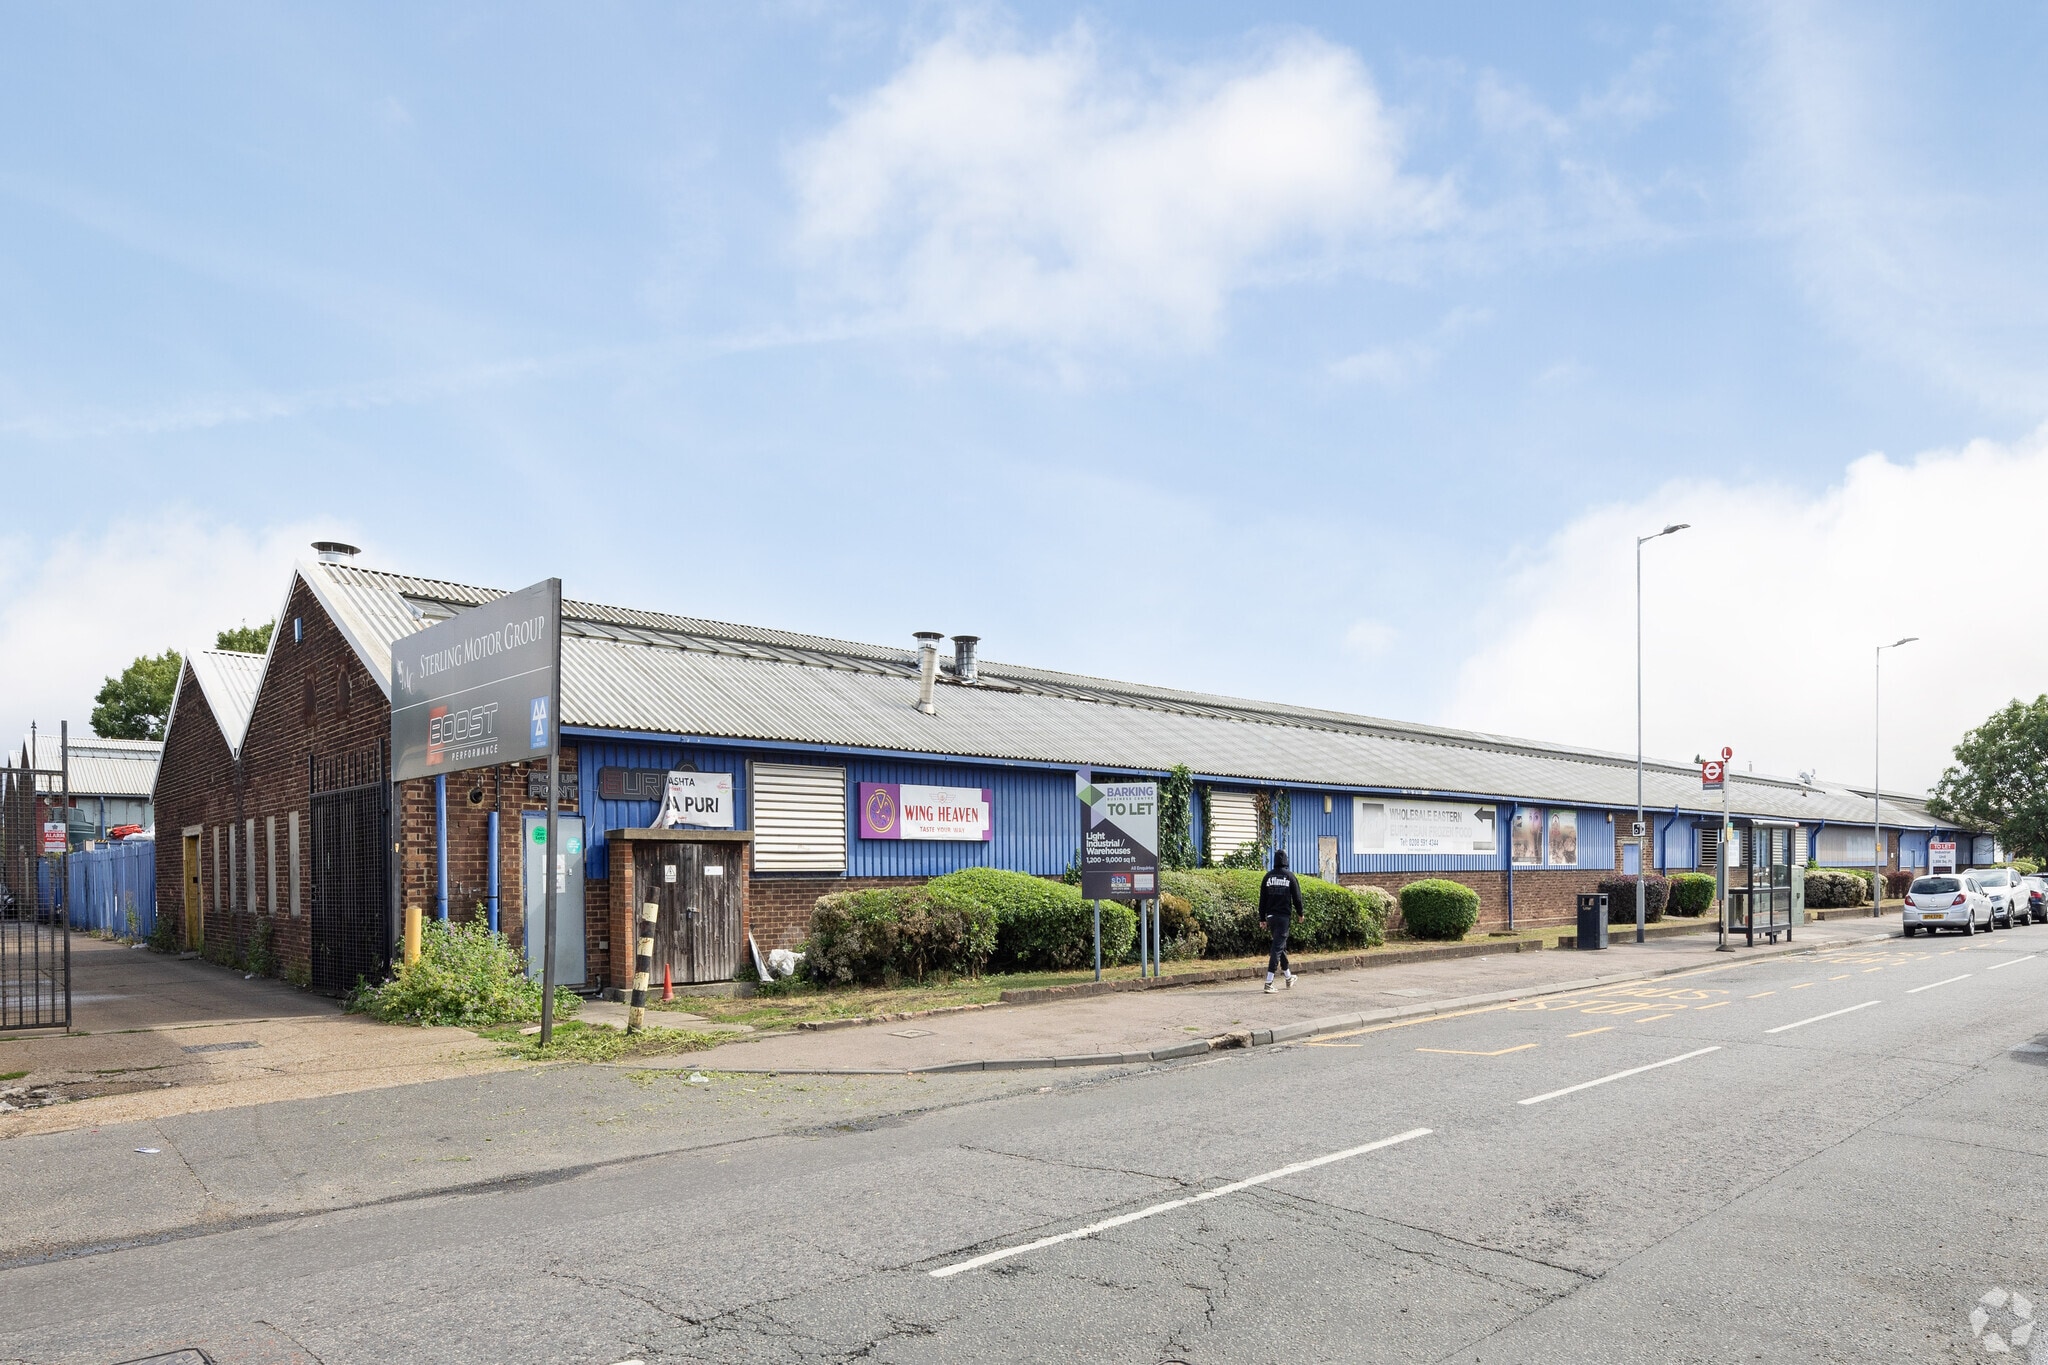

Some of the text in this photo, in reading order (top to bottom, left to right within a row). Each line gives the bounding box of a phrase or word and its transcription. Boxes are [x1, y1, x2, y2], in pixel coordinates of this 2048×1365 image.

[419, 615, 545, 679] STERLING MOTOR GROUP
[429, 702, 499, 747] BOOST
[451, 744, 498, 761] PERFORMANCE
[1723, 748, 1730, 758] L
[561, 773, 578, 783] UP
[529, 784, 578, 798] PONT
[1107, 786, 1154, 797] BARKING
[685, 796, 719, 812] PURI
[1107, 802, 1154, 816] TO LET
[904, 805, 979, 823] WING HEAVEN
[1389, 808, 1463, 823] WHOLESALE EASTERN
[1086, 832, 1106, 841] Light
[1429, 824, 1454, 838] FROZEN
[1454, 825, 1473, 838] FOOD
[1086, 839, 1120, 848] Industrial
[1086, 847, 1131, 855] Warehouses
[1086, 856, 1102, 864] 1,200
[1105, 856, 1122, 864] 9,000
[1111, 876, 1127, 884] sbh
[1595, 987, 1730, 1000] BUS
[1506, 999, 1689, 1015] STOP
